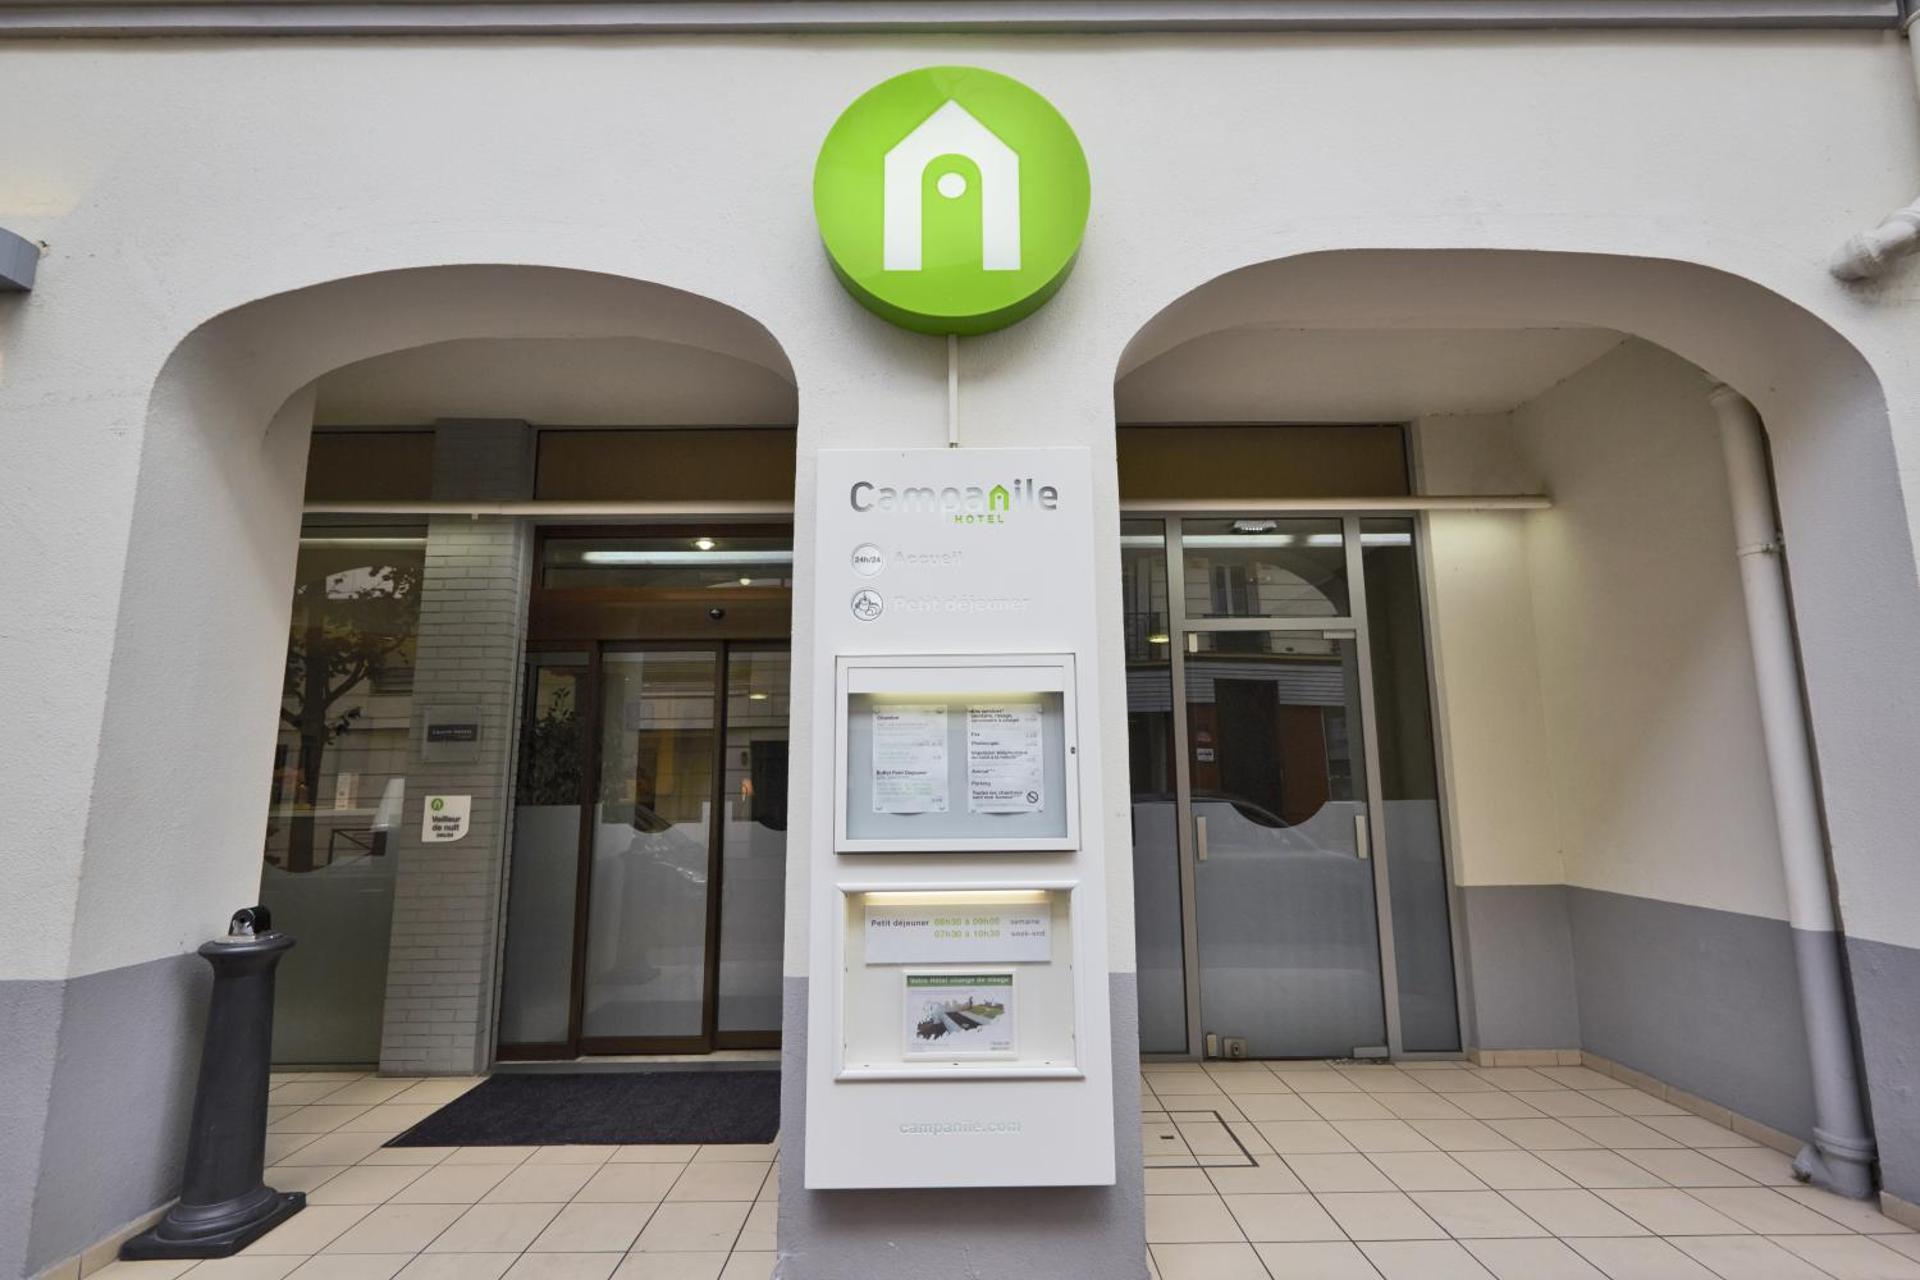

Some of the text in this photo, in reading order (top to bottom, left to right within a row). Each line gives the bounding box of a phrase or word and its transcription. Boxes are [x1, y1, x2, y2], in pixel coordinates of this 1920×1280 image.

[850, 478, 1058, 515] Campanile
[954, 515, 1005, 524] HOTEL
[871, 919, 891, 927] Petit
[893, 918, 929, 928] déjeuner
[899, 1119, 1022, 1135] campanile.com
